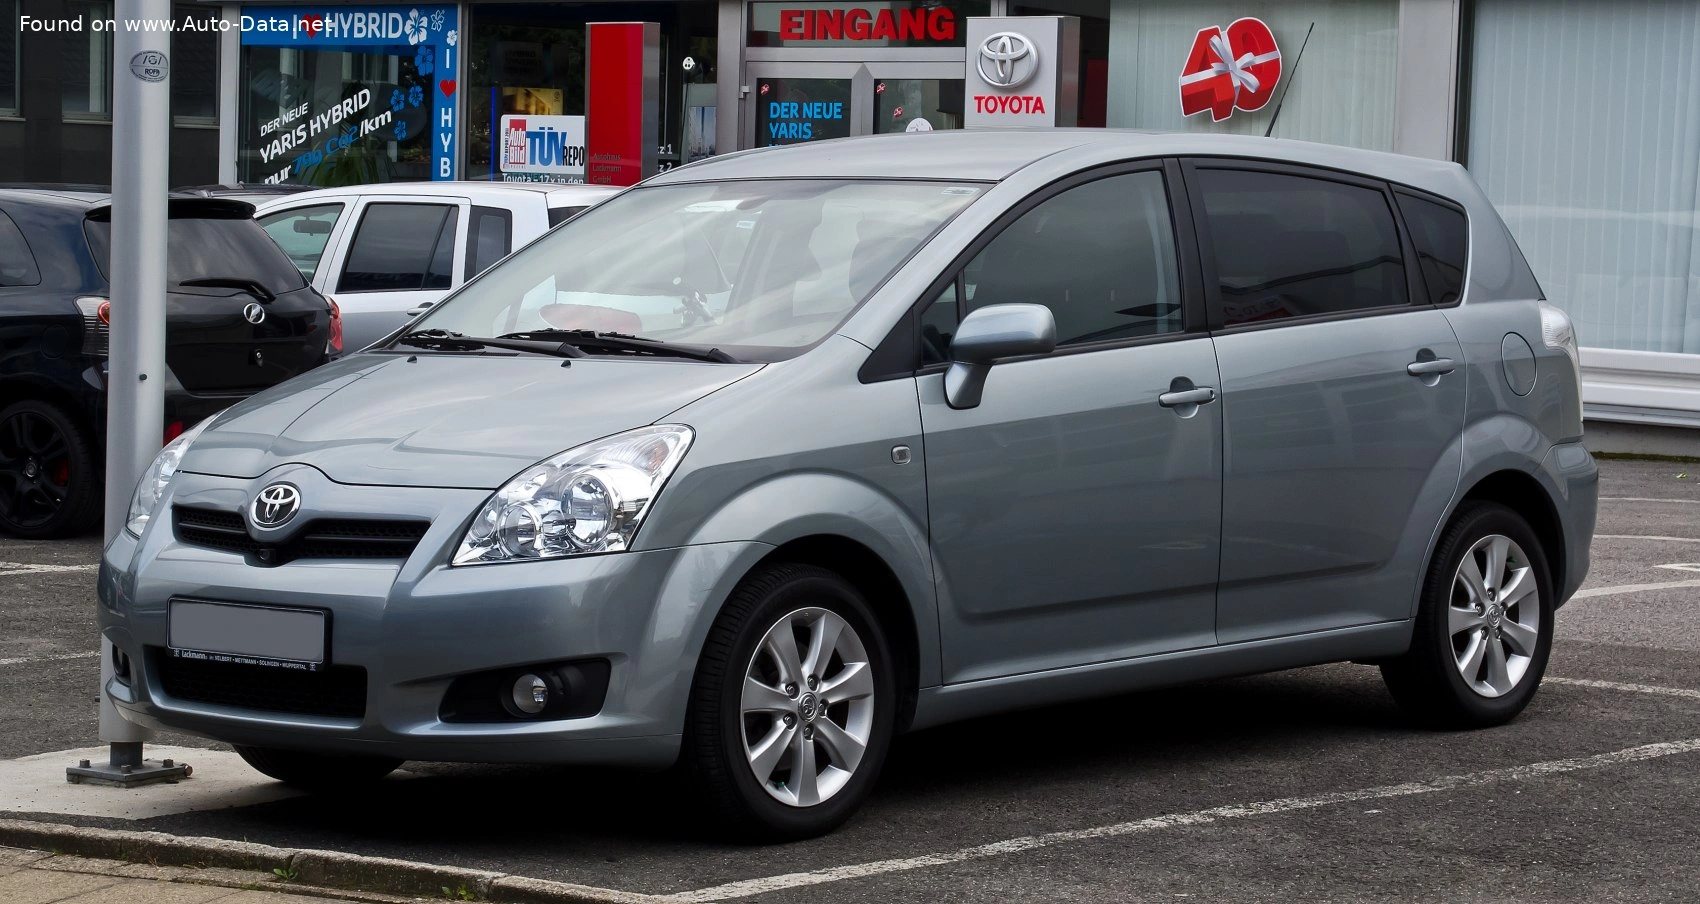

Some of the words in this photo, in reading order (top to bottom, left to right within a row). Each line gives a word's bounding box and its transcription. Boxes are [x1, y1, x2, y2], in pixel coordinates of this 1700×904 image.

[325, 12, 403, 39] HYBRID
[779, 9, 956, 40] EINGANG
[260, 117, 280, 137] DER
[281, 101, 309, 126] NEUE
[769, 101, 800, 119] DER
[802, 102, 843, 119] NEUE
[974, 95, 1046, 114] TOYOTA
[260, 123, 307, 164] YARIS
[309, 88, 371, 137] HYBRID
[769, 122, 812, 139] YARIS
[525, 126, 568, 167] TÜV
